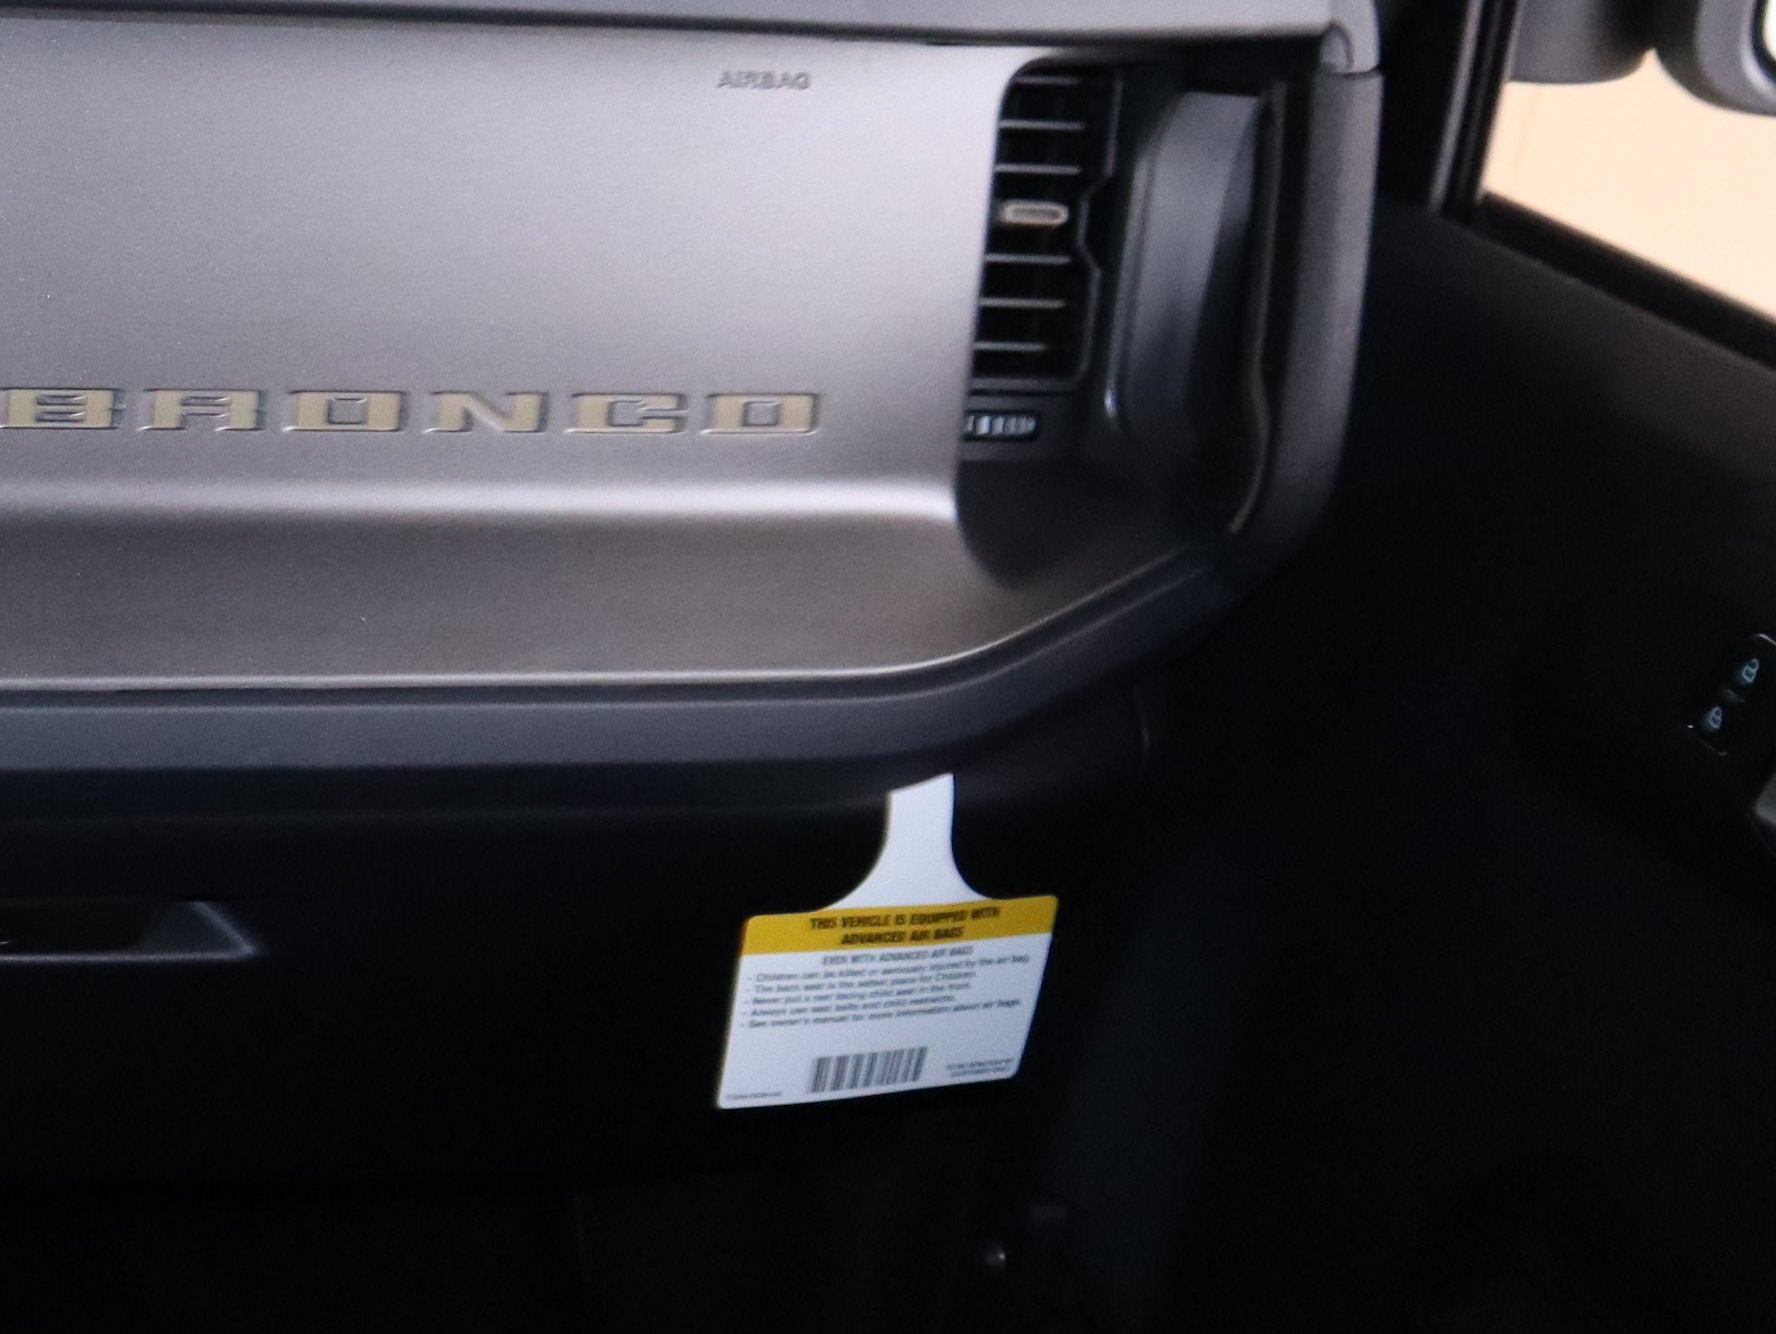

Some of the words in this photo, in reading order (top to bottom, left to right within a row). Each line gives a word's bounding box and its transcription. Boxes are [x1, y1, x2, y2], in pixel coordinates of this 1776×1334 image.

[716, 69, 812, 93] AIRBAG
[810, 916, 838, 930] THIS
[841, 913, 891, 929] VEHICLE
[840, 930, 906, 945] ADVANCED
